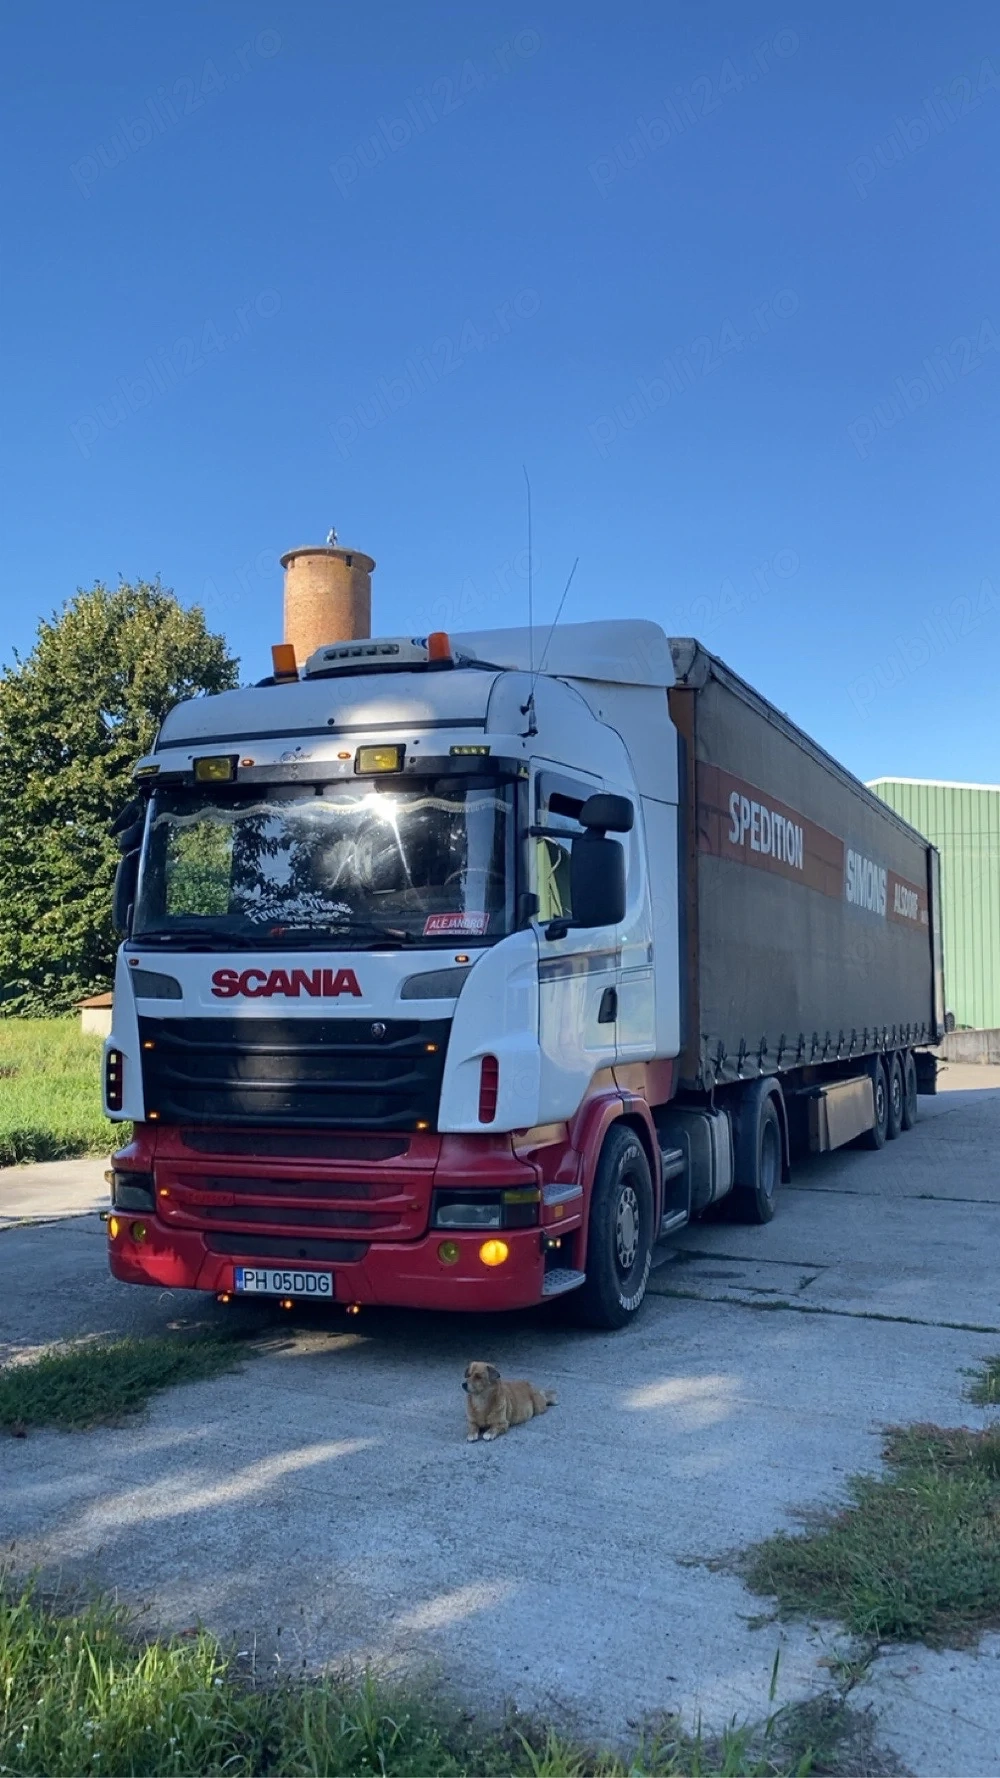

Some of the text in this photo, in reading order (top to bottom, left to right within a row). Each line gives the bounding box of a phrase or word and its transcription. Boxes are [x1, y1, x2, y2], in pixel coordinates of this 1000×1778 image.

[728, 791, 804, 870] SPEDITION
[846, 849, 887, 916] SIMONS
[211, 968, 362, 999] SCANIA
[244, 1271, 330, 1293] PH 05DDG
